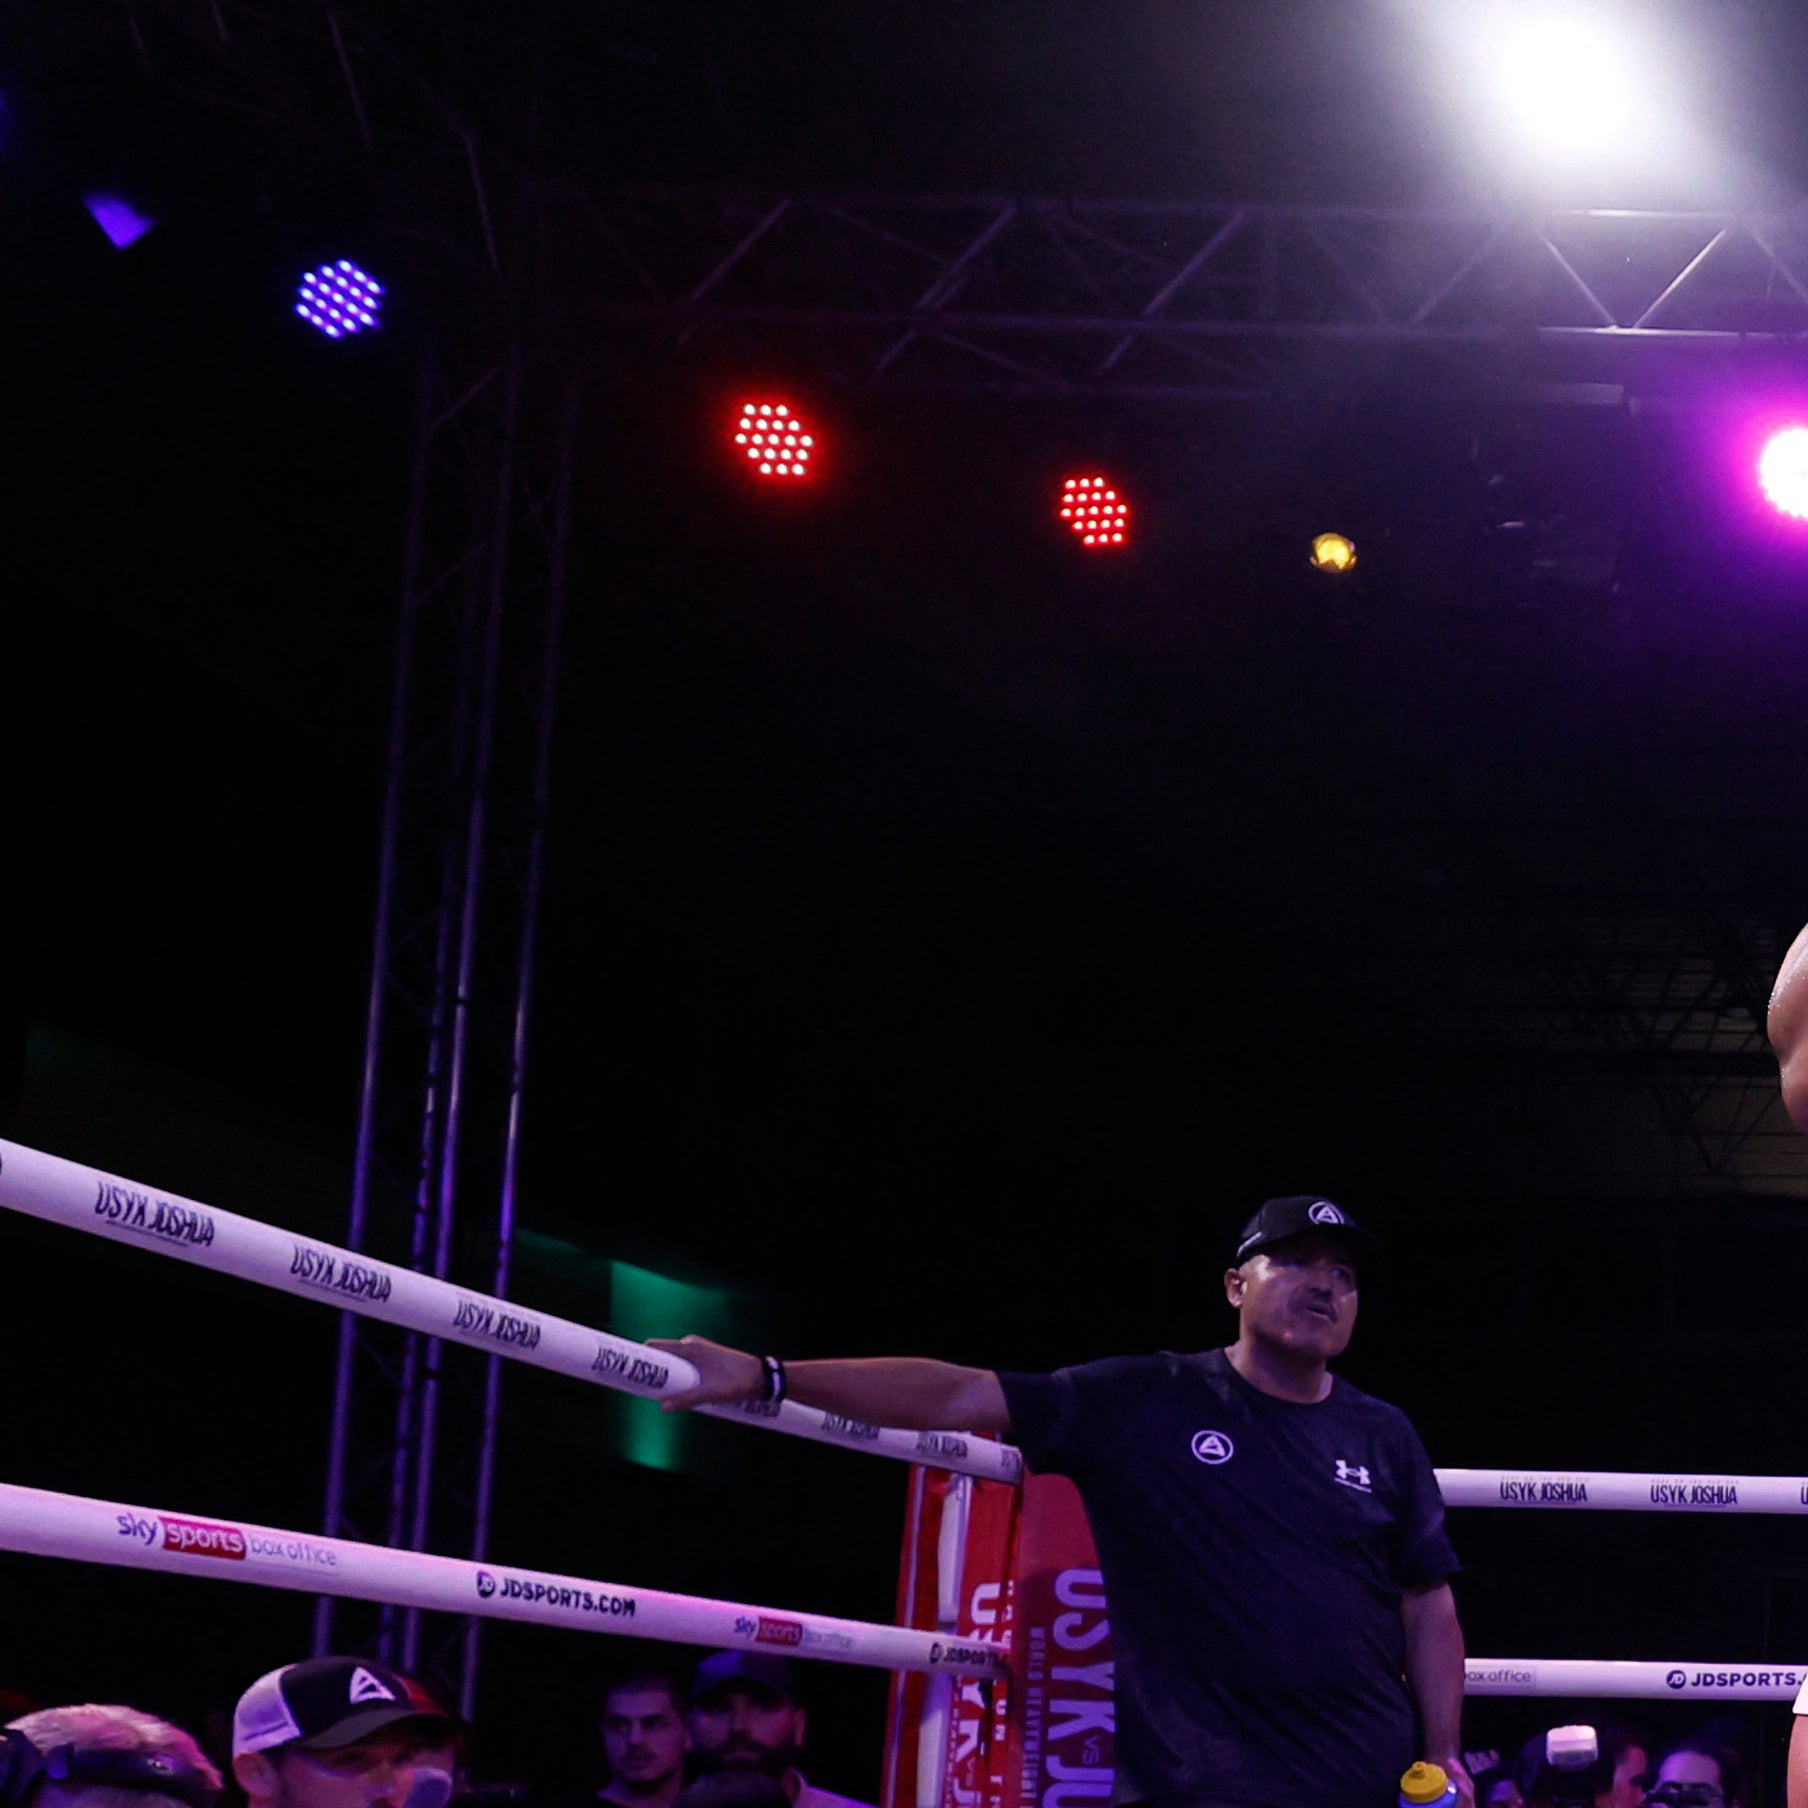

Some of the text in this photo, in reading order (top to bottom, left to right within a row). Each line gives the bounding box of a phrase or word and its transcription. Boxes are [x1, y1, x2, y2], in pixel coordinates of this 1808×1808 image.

[1500, 1481, 1588, 1502] USYK JOSHUA
[1650, 1484, 1738, 1505] USYK JOSHUA
[117, 1513, 337, 1566] sky sports box office
[501, 1578, 636, 1617] JDSPORTS.COM
[1047, 1568, 1117, 1741] USYK
[1488, 1668, 1532, 1684] office
